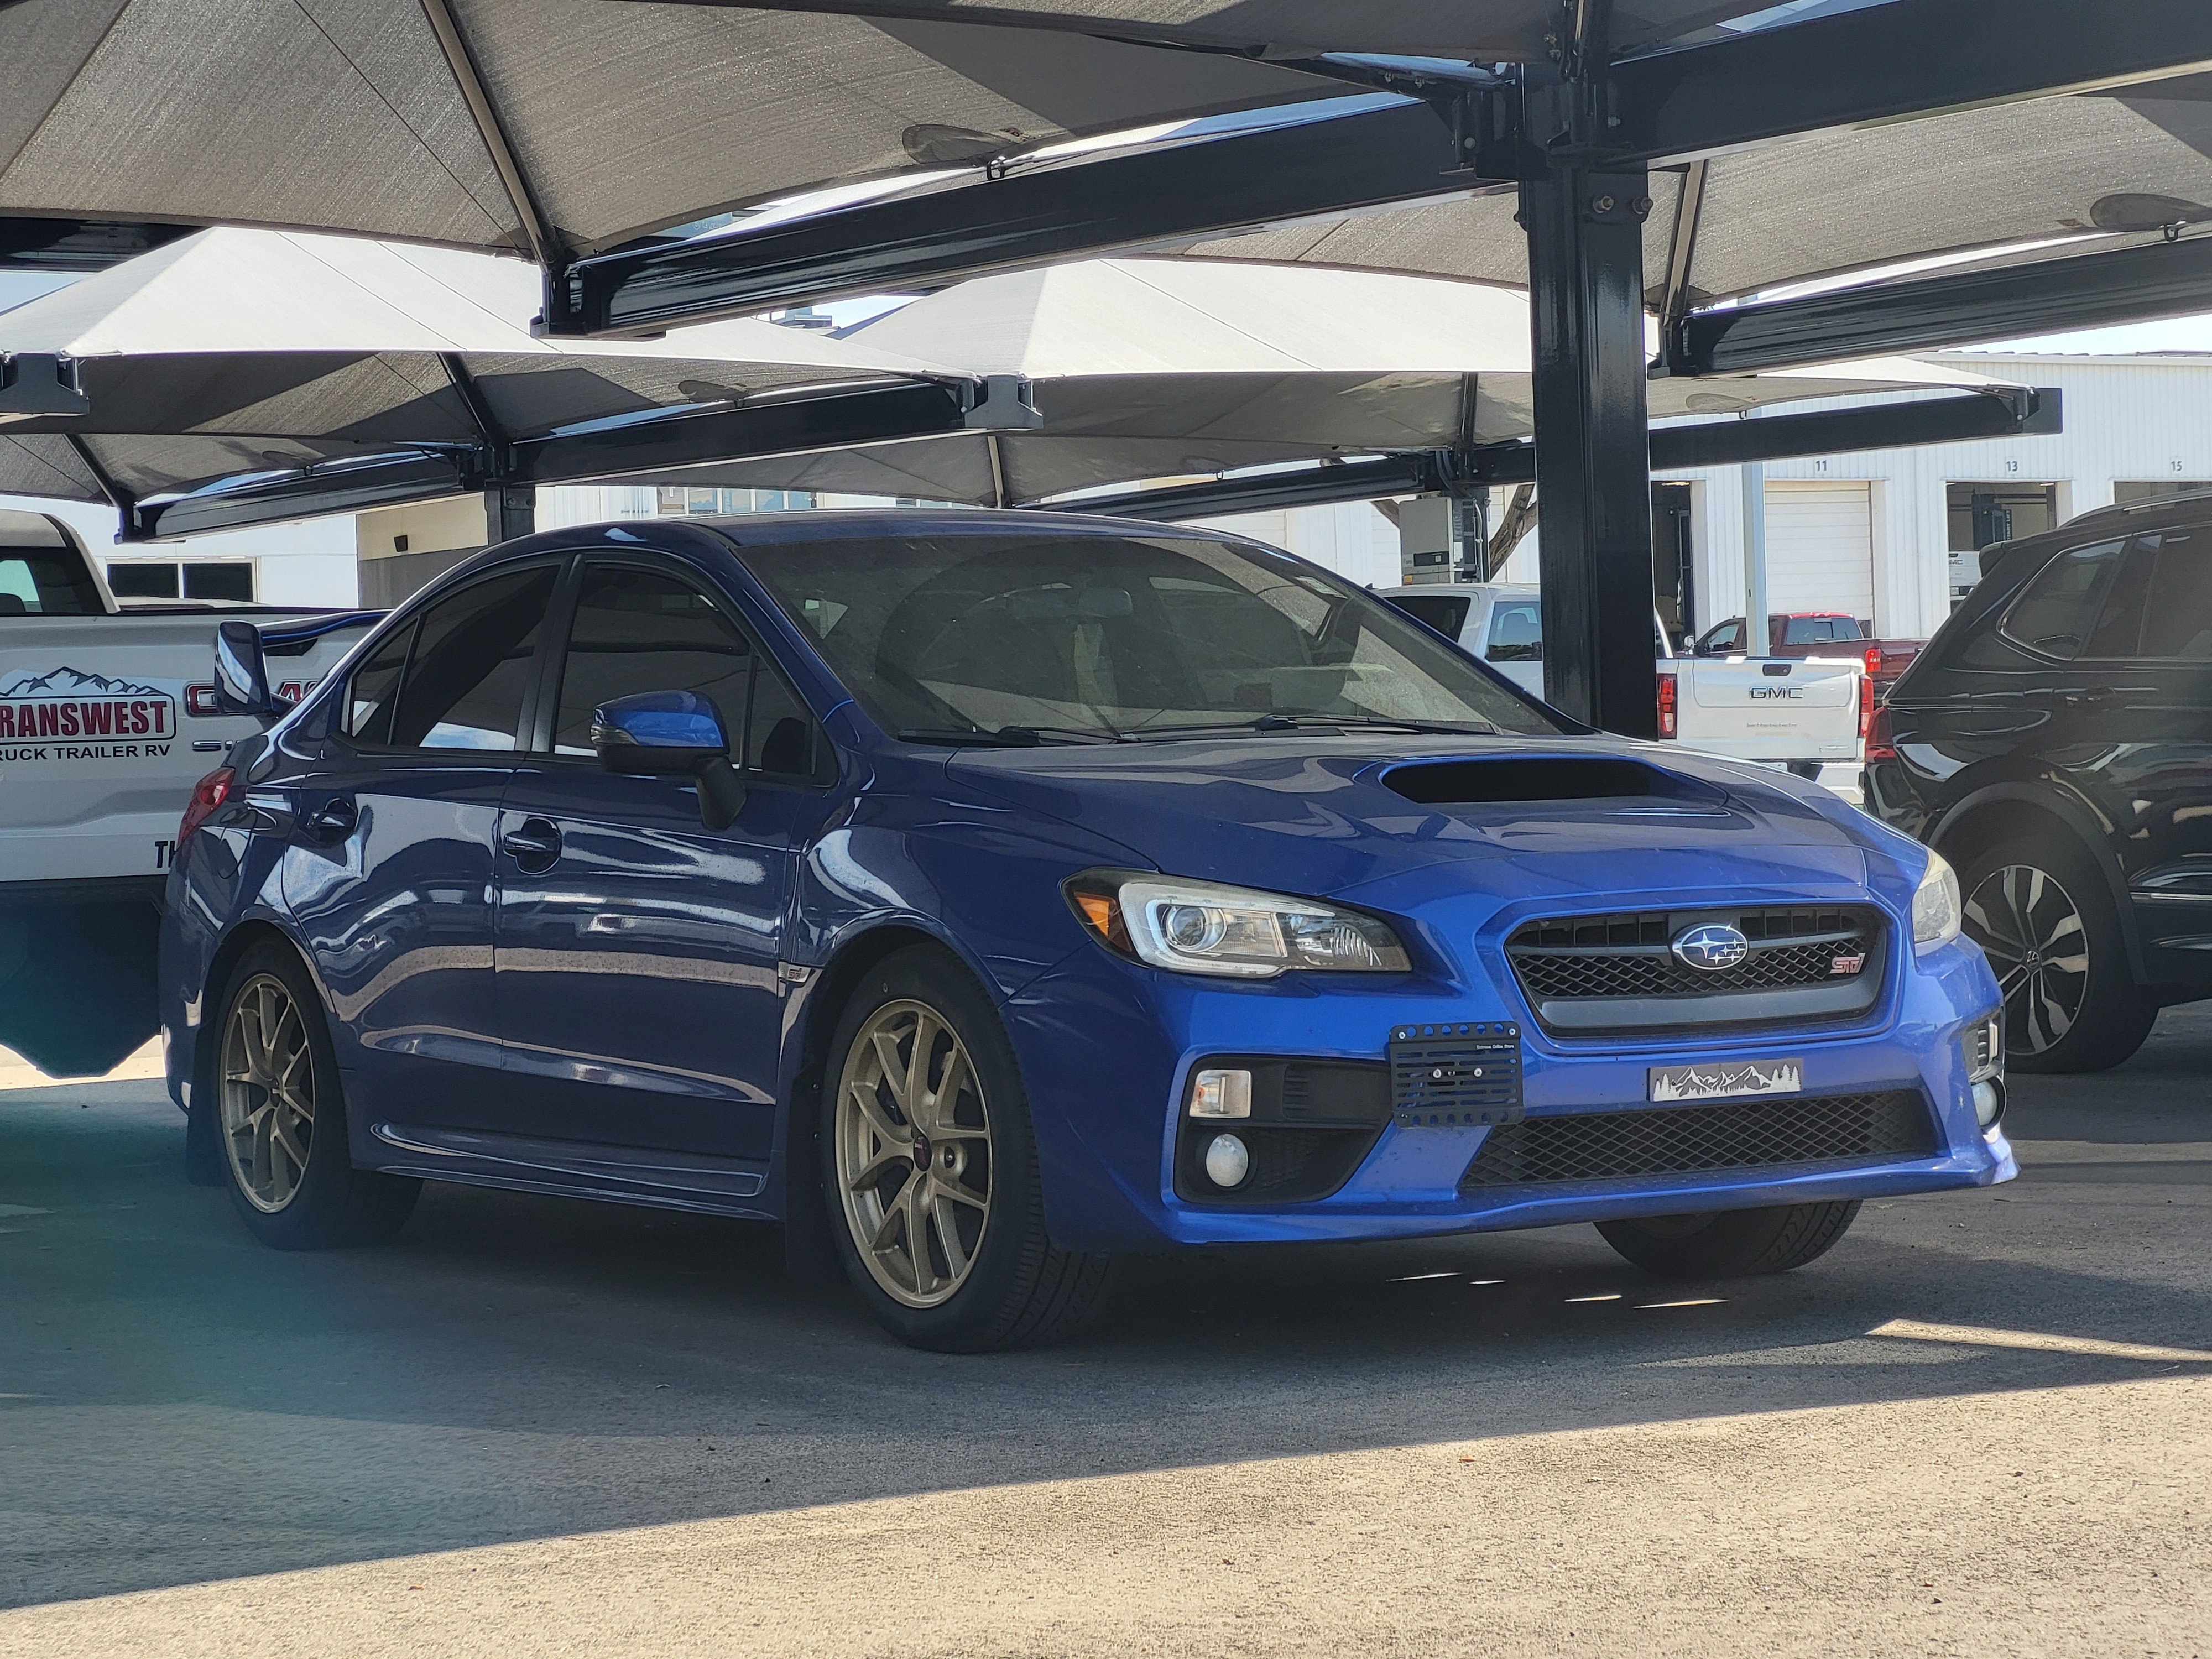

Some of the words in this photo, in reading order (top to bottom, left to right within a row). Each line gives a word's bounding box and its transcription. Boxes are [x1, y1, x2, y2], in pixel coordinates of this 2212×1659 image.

[1815, 460, 1827, 471] 11
[2006, 461, 2018, 471] 13
[2171, 461, 2182, 471] 15
[1750, 686, 1804, 699] GMC
[54, 745, 139, 759] TRAILER
[145, 744, 171, 757] RV
